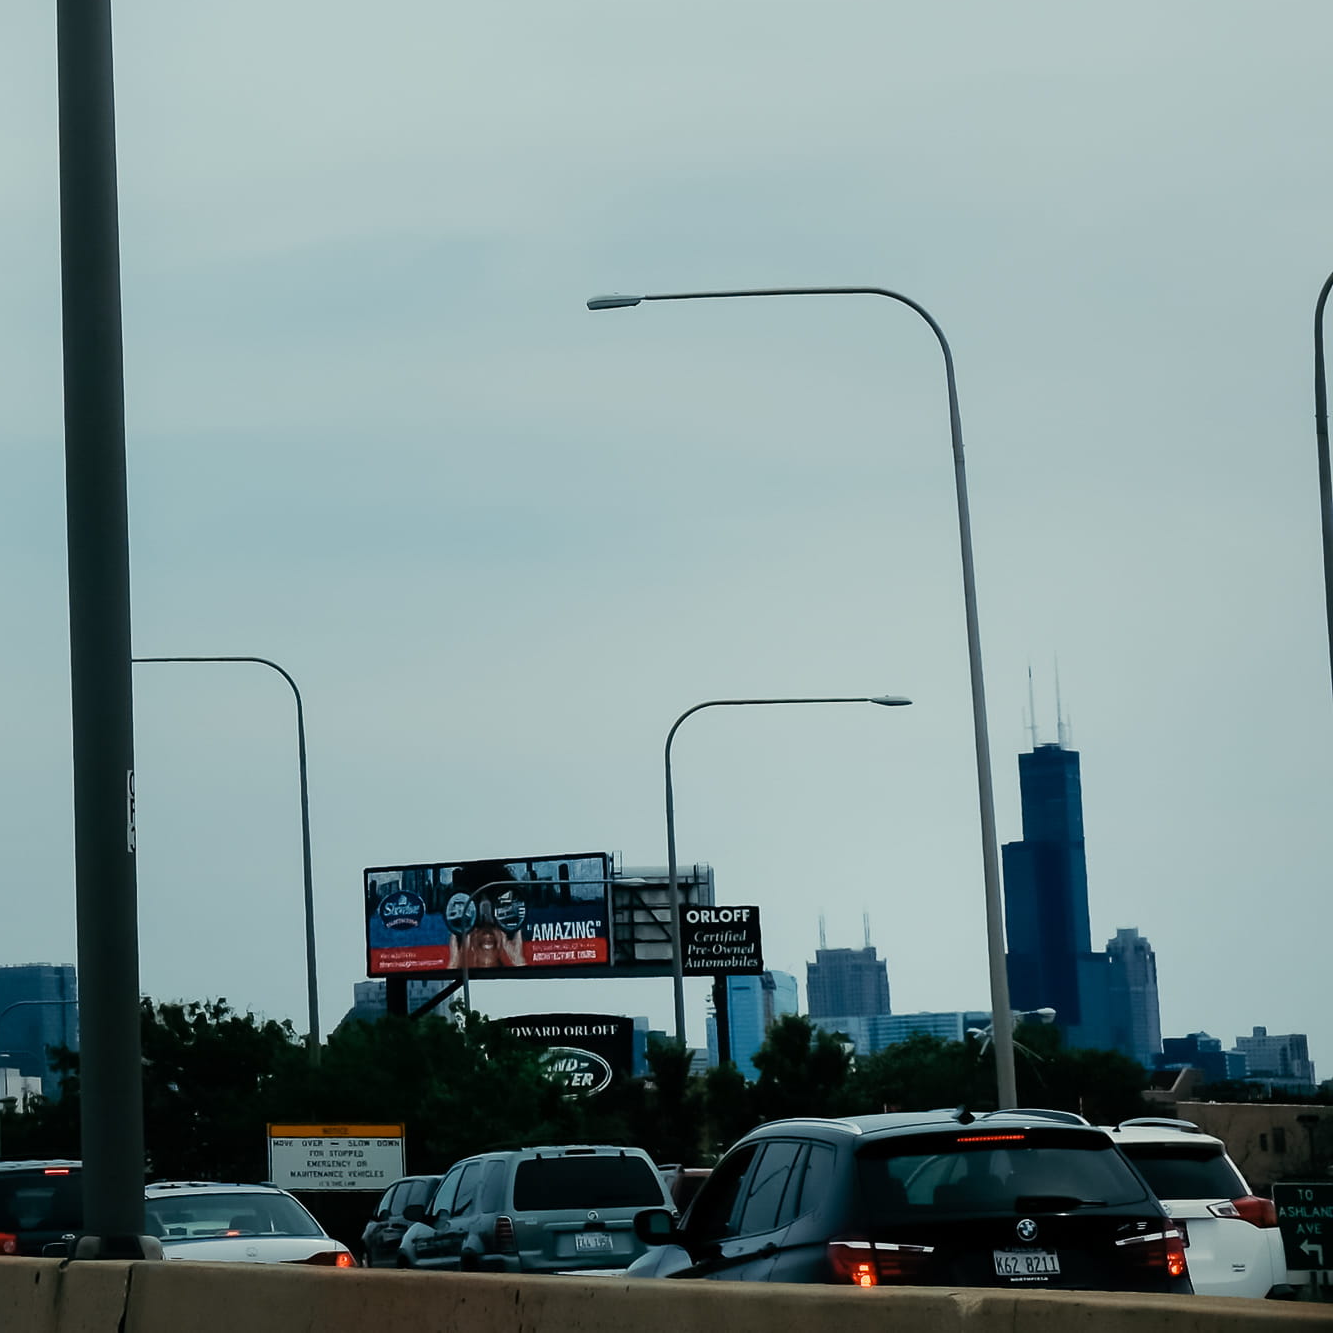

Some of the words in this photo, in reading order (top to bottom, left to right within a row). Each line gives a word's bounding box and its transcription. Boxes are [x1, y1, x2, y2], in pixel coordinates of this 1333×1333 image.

[686, 909, 750, 924] ORLOFF
[694, 930, 746, 943] Certified
[687, 943, 754, 955] Pre-Owned
[684, 955, 758, 968] Automobiles
[564, 1025, 618, 1036] ORLOFF
[347, 1170, 384, 1178] VEHICLES
[1298, 1189, 1314, 1201] TO
[1296, 1223, 1322, 1235] AVE
